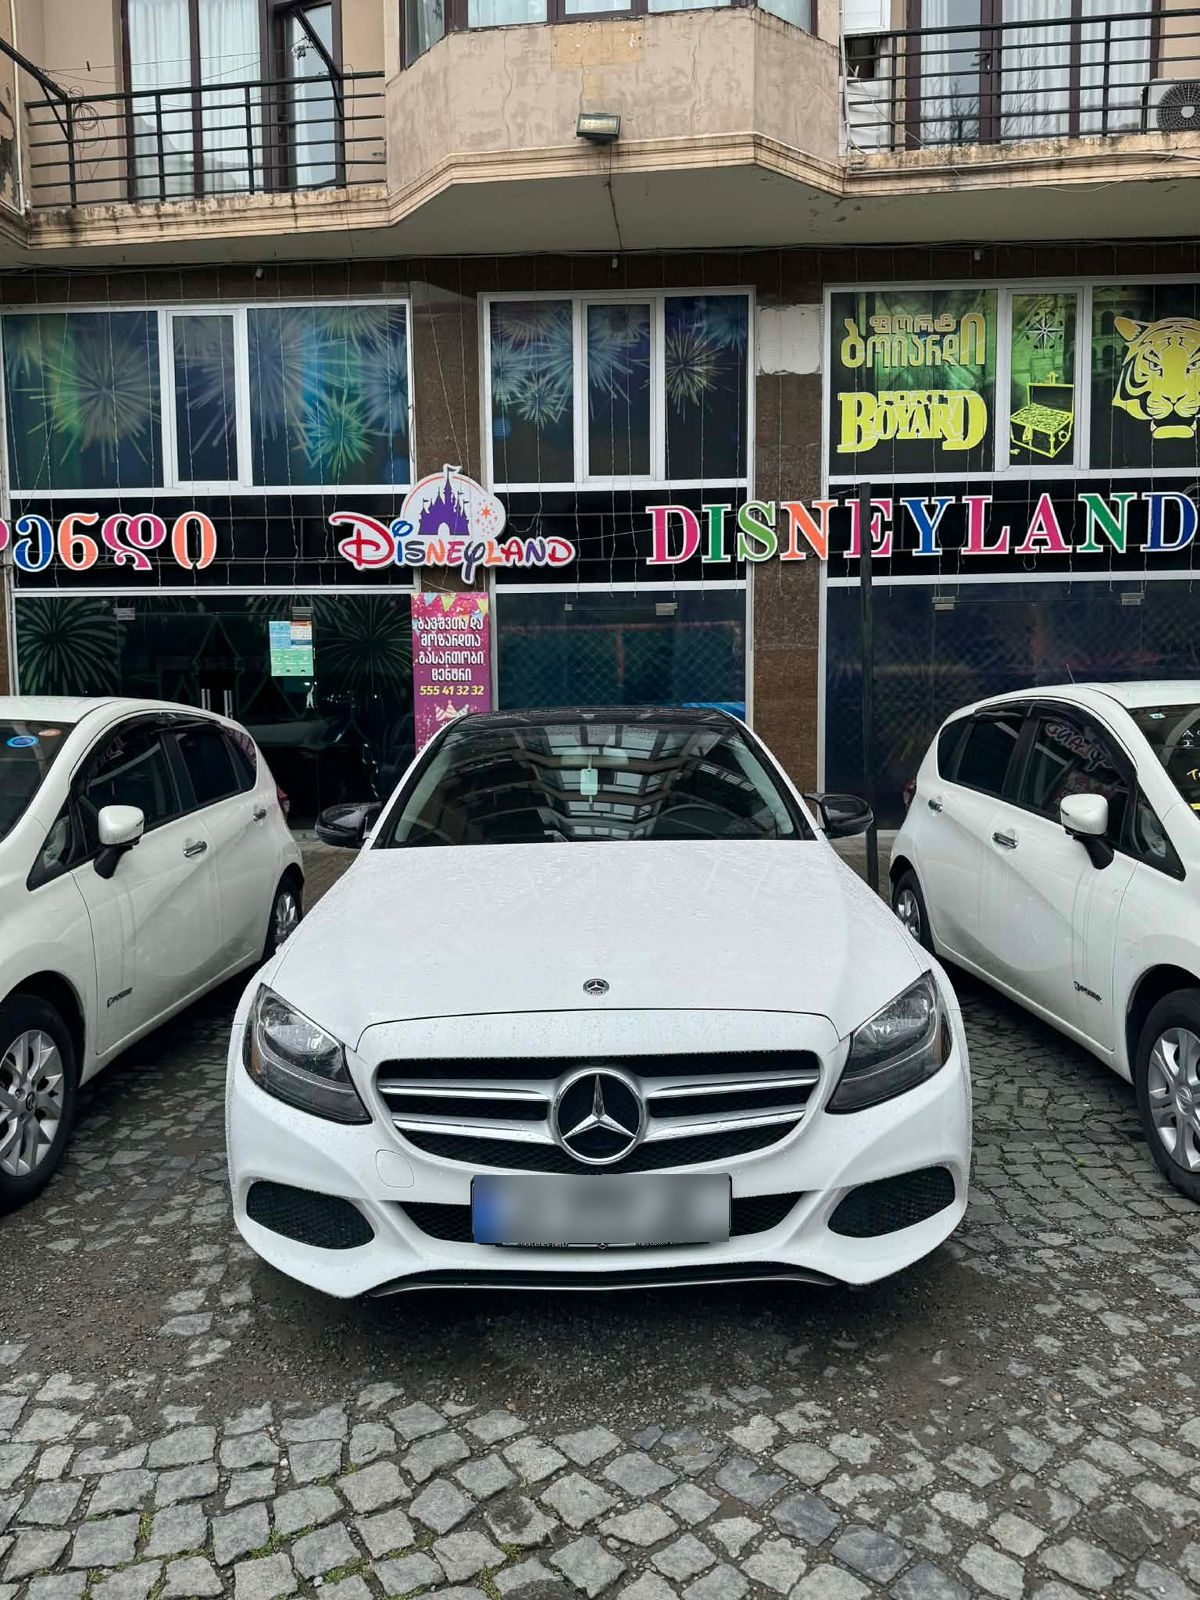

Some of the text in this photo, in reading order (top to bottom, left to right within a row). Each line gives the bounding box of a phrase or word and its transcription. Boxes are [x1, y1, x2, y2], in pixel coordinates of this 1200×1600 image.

[869, 314, 957, 334] ფორტ
[841, 312, 986, 369] ბოიარდი
[836, 390, 988, 454] BOYARD
[645, 492, 1199, 566] DISNEYLAND
[0, 511, 217, 573] ენდი
[418, 616, 484, 631] ბავშვთა და
[421, 633, 481, 647] მოზარდთა
[419, 650, 485, 665] გასართობი
[431, 668, 472, 682] ცენტრი
[420, 685, 485, 696] 555 41 32 32
